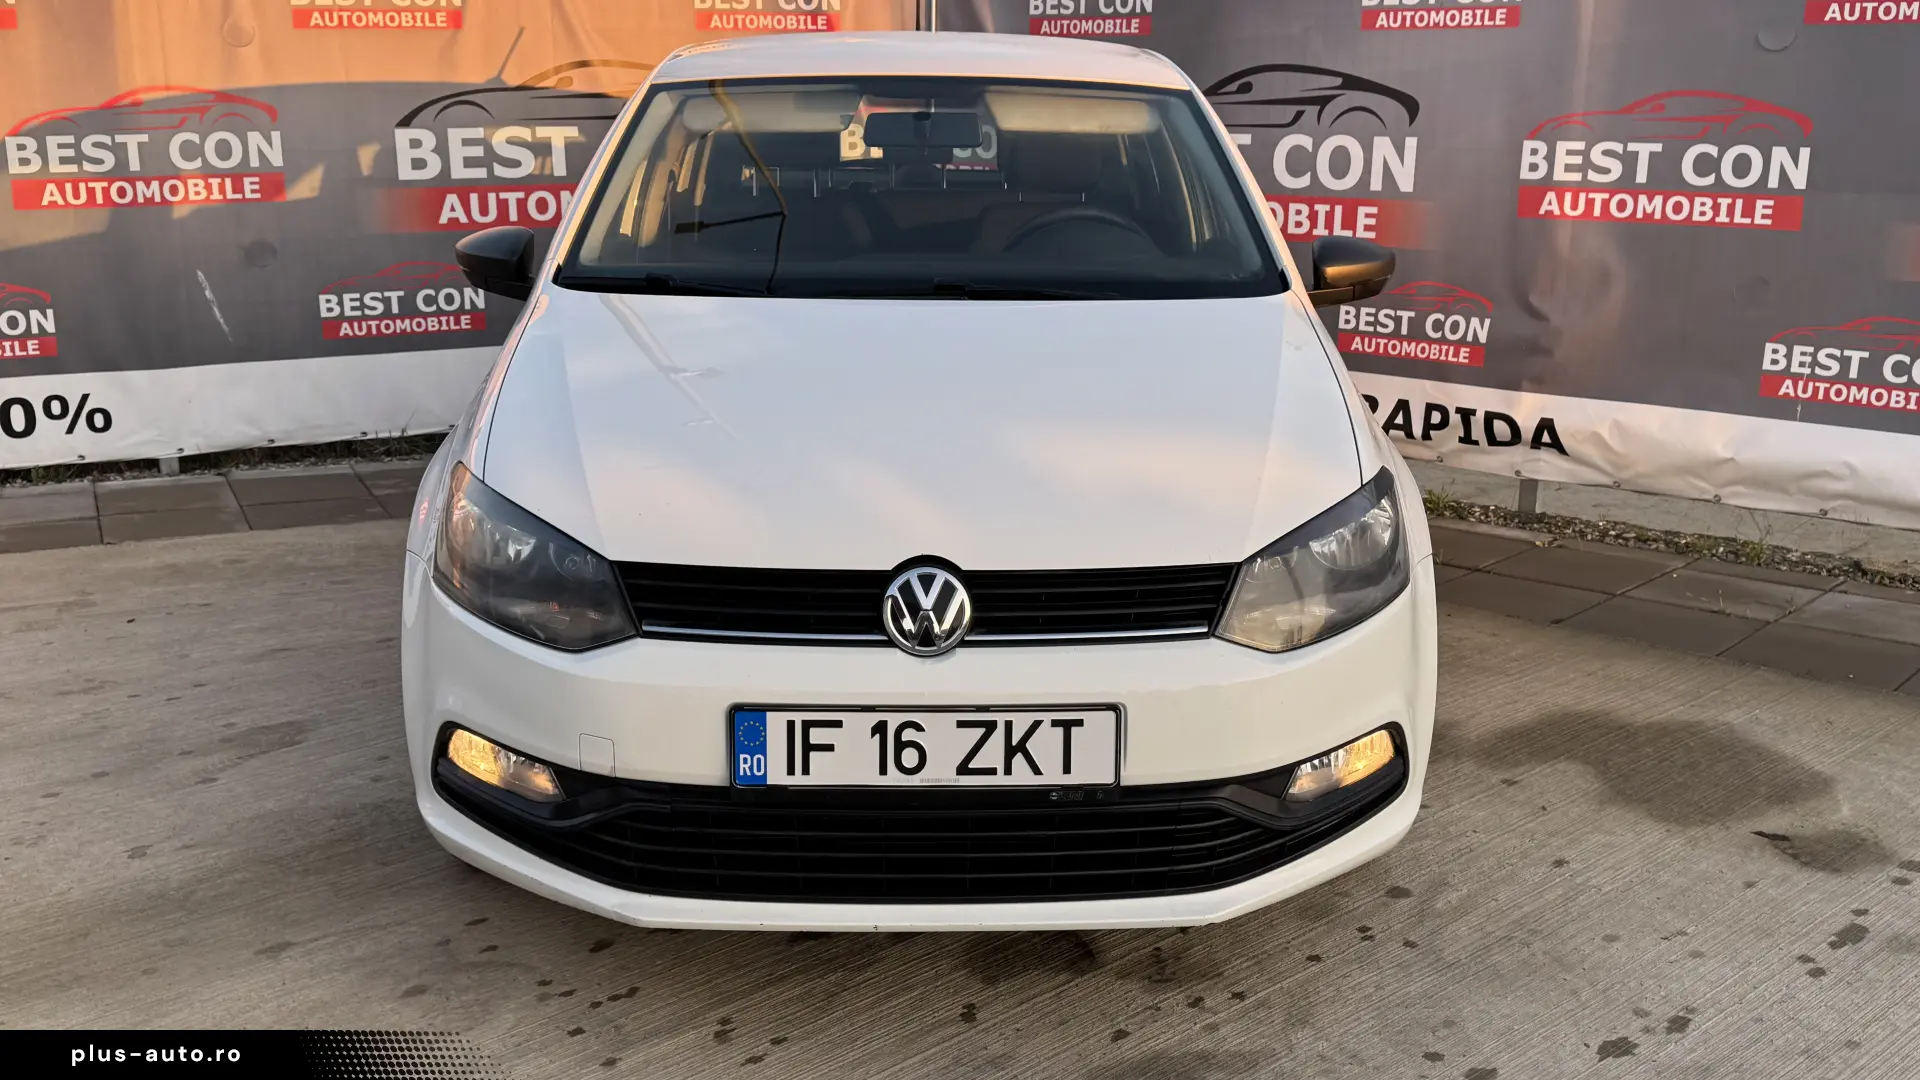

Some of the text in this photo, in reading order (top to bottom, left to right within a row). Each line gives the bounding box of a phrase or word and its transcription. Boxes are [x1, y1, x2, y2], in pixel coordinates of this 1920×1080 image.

[310, 11, 447, 27] AUTOMOBILE
[709, 14, 827, 30] AUTOMOBILE
[1375, 8, 1507, 29] AUTOMOBILE
[1824, 1, 1920, 21] AUTOM
[1040, 18, 1140, 35] AUTOMOBILE
[5, 130, 284, 174] BEST CON
[394, 126, 579, 181] BEST
[1273, 133, 1418, 192] CON
[1519, 139, 1811, 190] BEST CON
[41, 177, 262, 206] AUTOMOBILE
[438, 190, 577, 225] AUTO
[1538, 190, 1775, 225] AUTOMOBILE
[318, 287, 486, 318] BEST CON
[339, 315, 472, 337] AUTOMOBILE
[1338, 304, 1492, 344] BEST CON
[0, 340, 41, 357] ILE
[1350, 336, 1471, 363] AUTOMOBILE
[1762, 342, 1920, 386] BEST C
[786, 718, 1085, 776] IF 16 ZKT
[739, 753, 765, 777] RO
